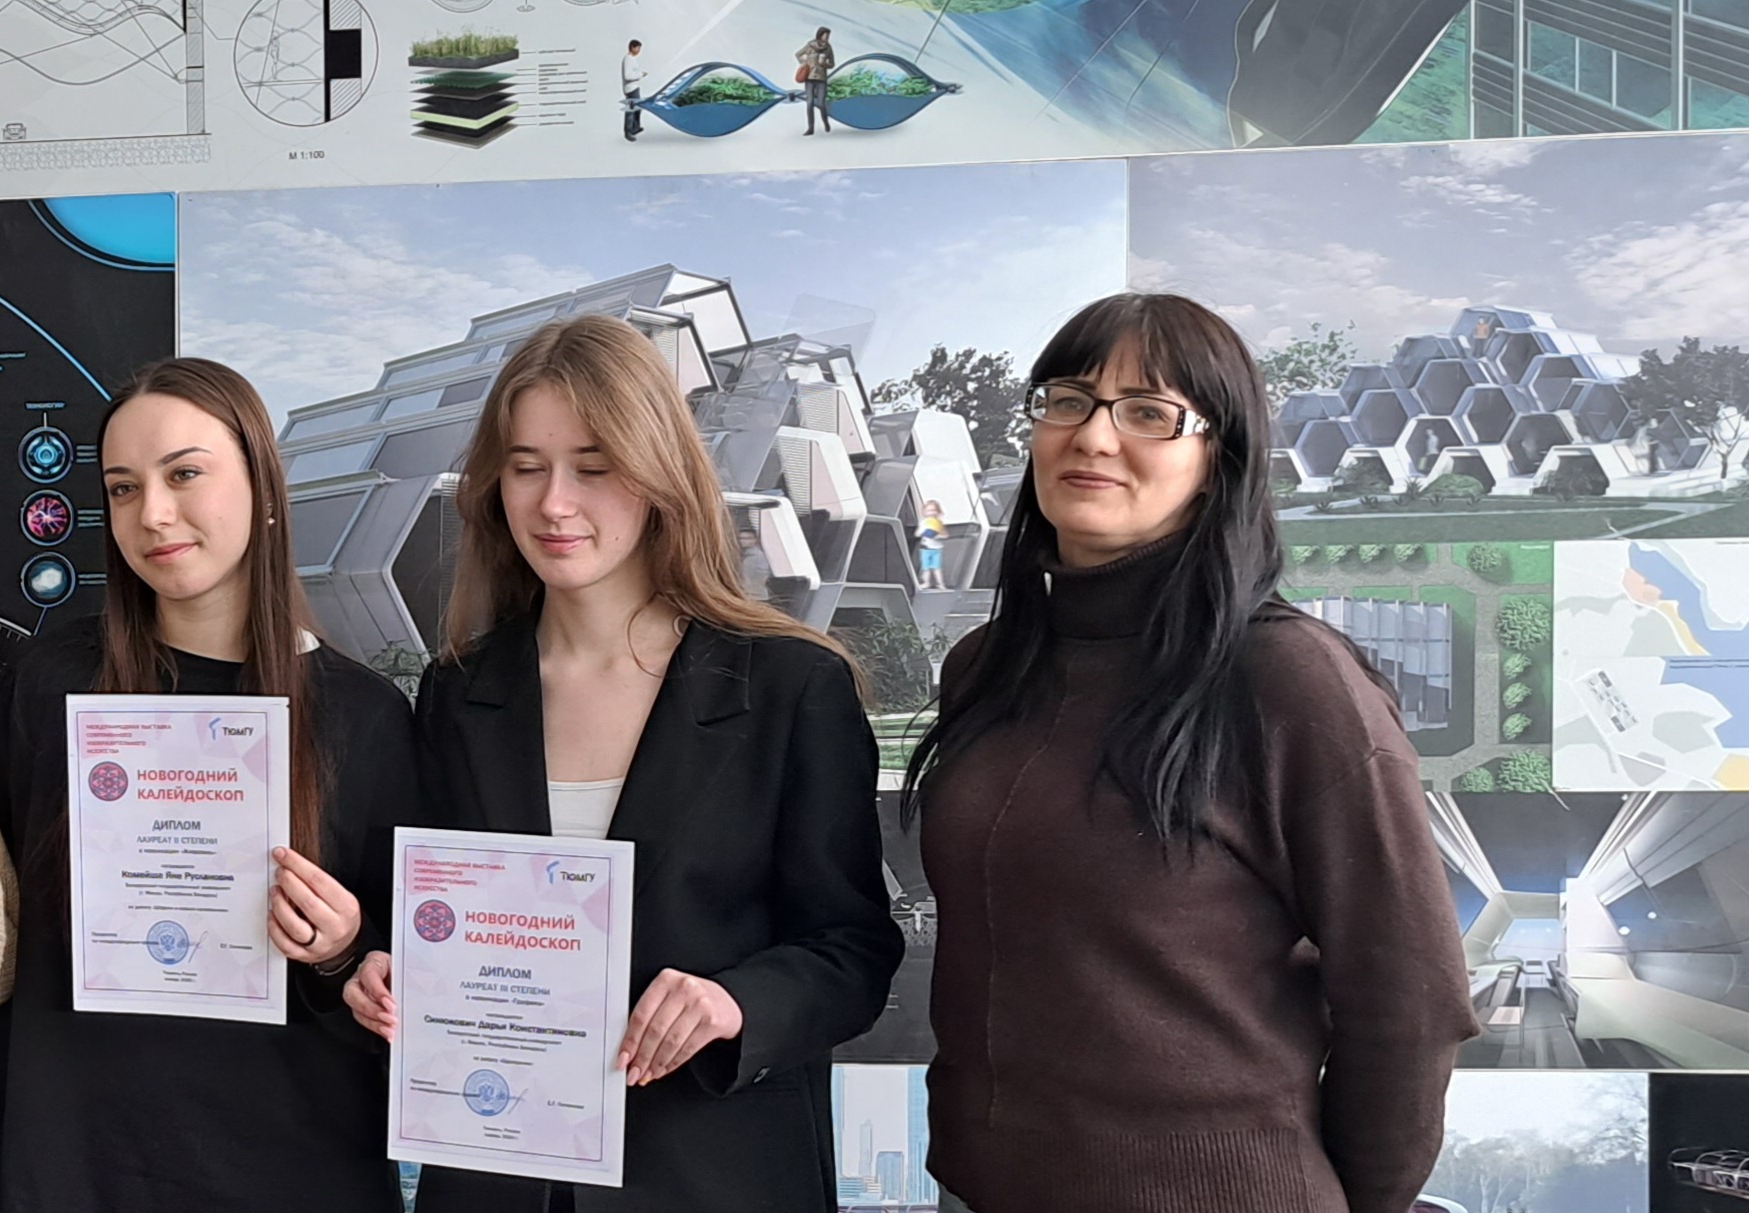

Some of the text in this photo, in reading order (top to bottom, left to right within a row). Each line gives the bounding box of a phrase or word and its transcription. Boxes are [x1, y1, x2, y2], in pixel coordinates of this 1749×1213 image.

[300, 150, 326, 160] 1:100
[137, 767, 238, 784] НОВОГОДНИЙ
[137, 786, 244, 803] КАЛЕЙДОСКОП
[152, 819, 201, 832] ДИПЛОМ
[465, 911, 575, 931] НОВОГОДНИЙ
[465, 931, 581, 951] КАЛЕЙДОСКОП
[478, 965, 532, 980] ДИПЛОМ
